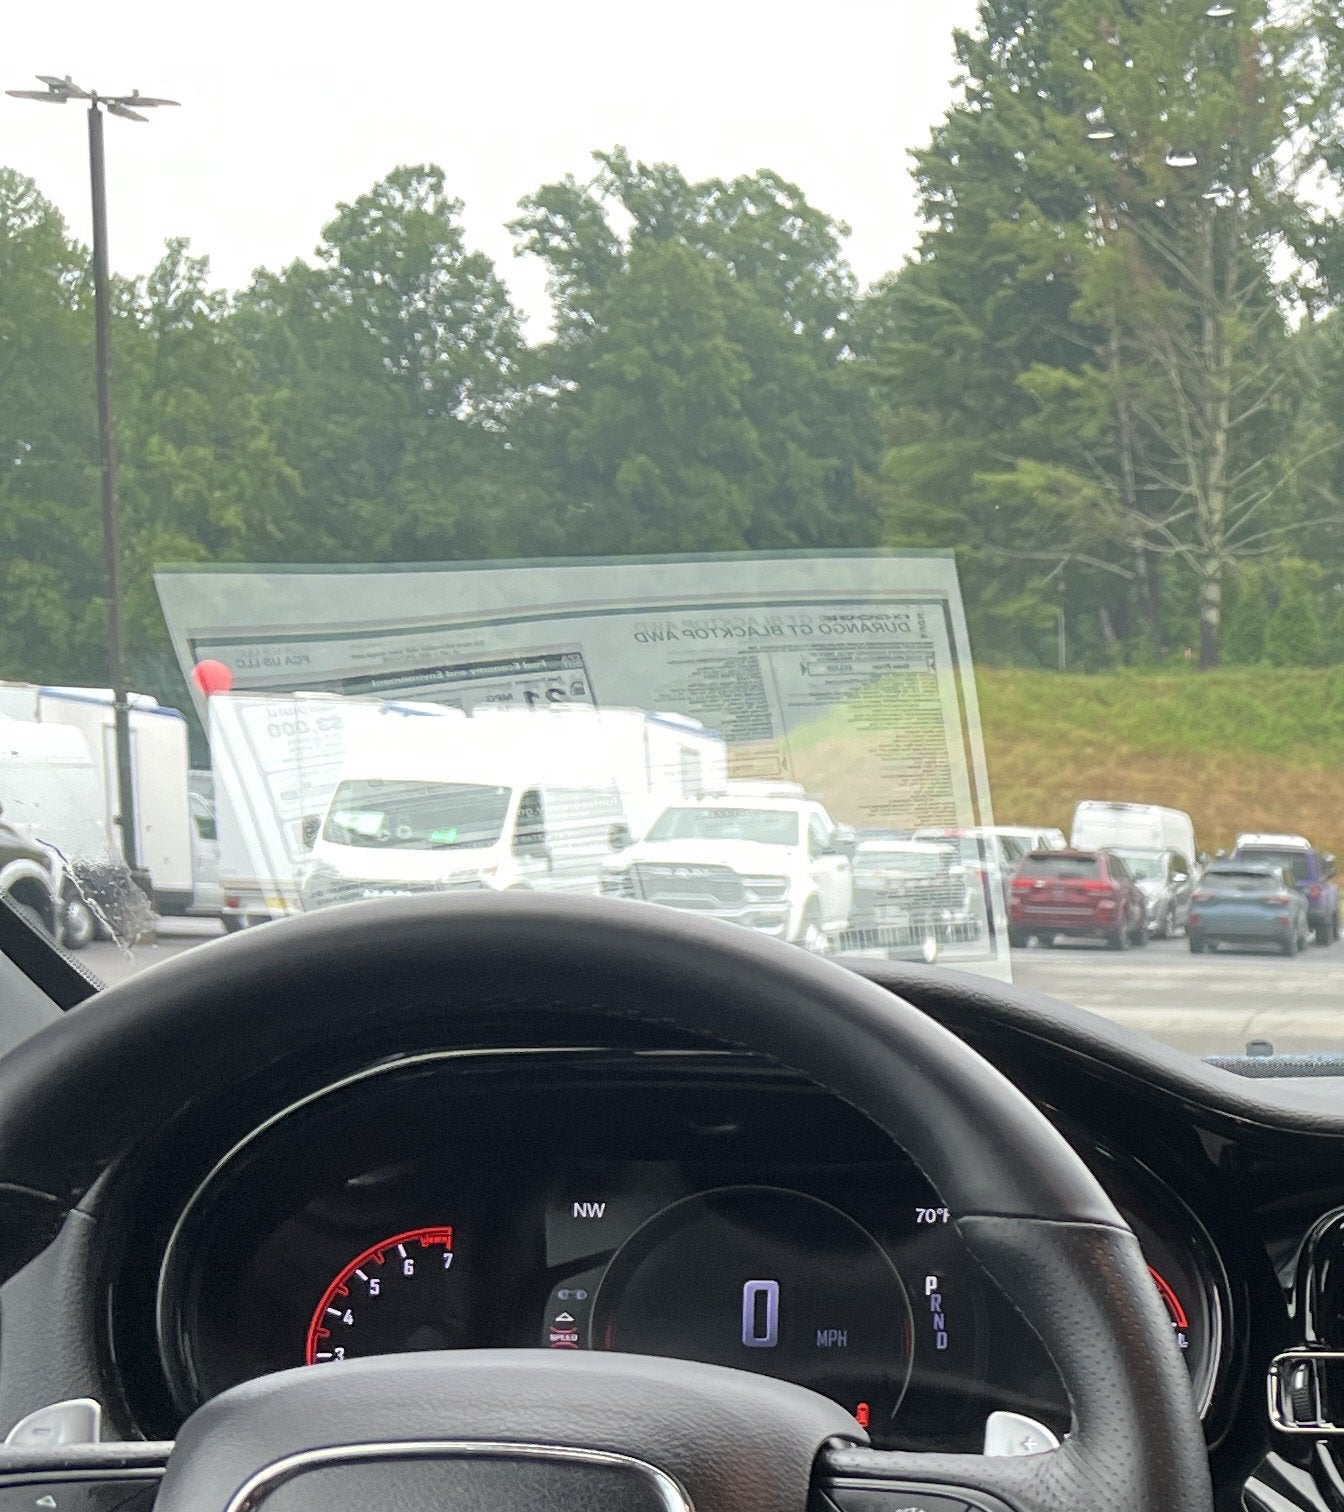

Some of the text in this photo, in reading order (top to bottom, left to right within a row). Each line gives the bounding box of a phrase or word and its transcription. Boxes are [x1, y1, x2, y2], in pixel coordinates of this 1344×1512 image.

[573, 1202, 606, 1219] NW
[403, 1258, 415, 1275] 6
[443, 1252, 453, 1269] 7
[369, 1278, 380, 1296] 5
[925, 1275, 938, 1296] P
[343, 1309, 354, 1325] 4
[742, 1279, 780, 1348] 0
[816, 1329, 848, 1347] MPH
